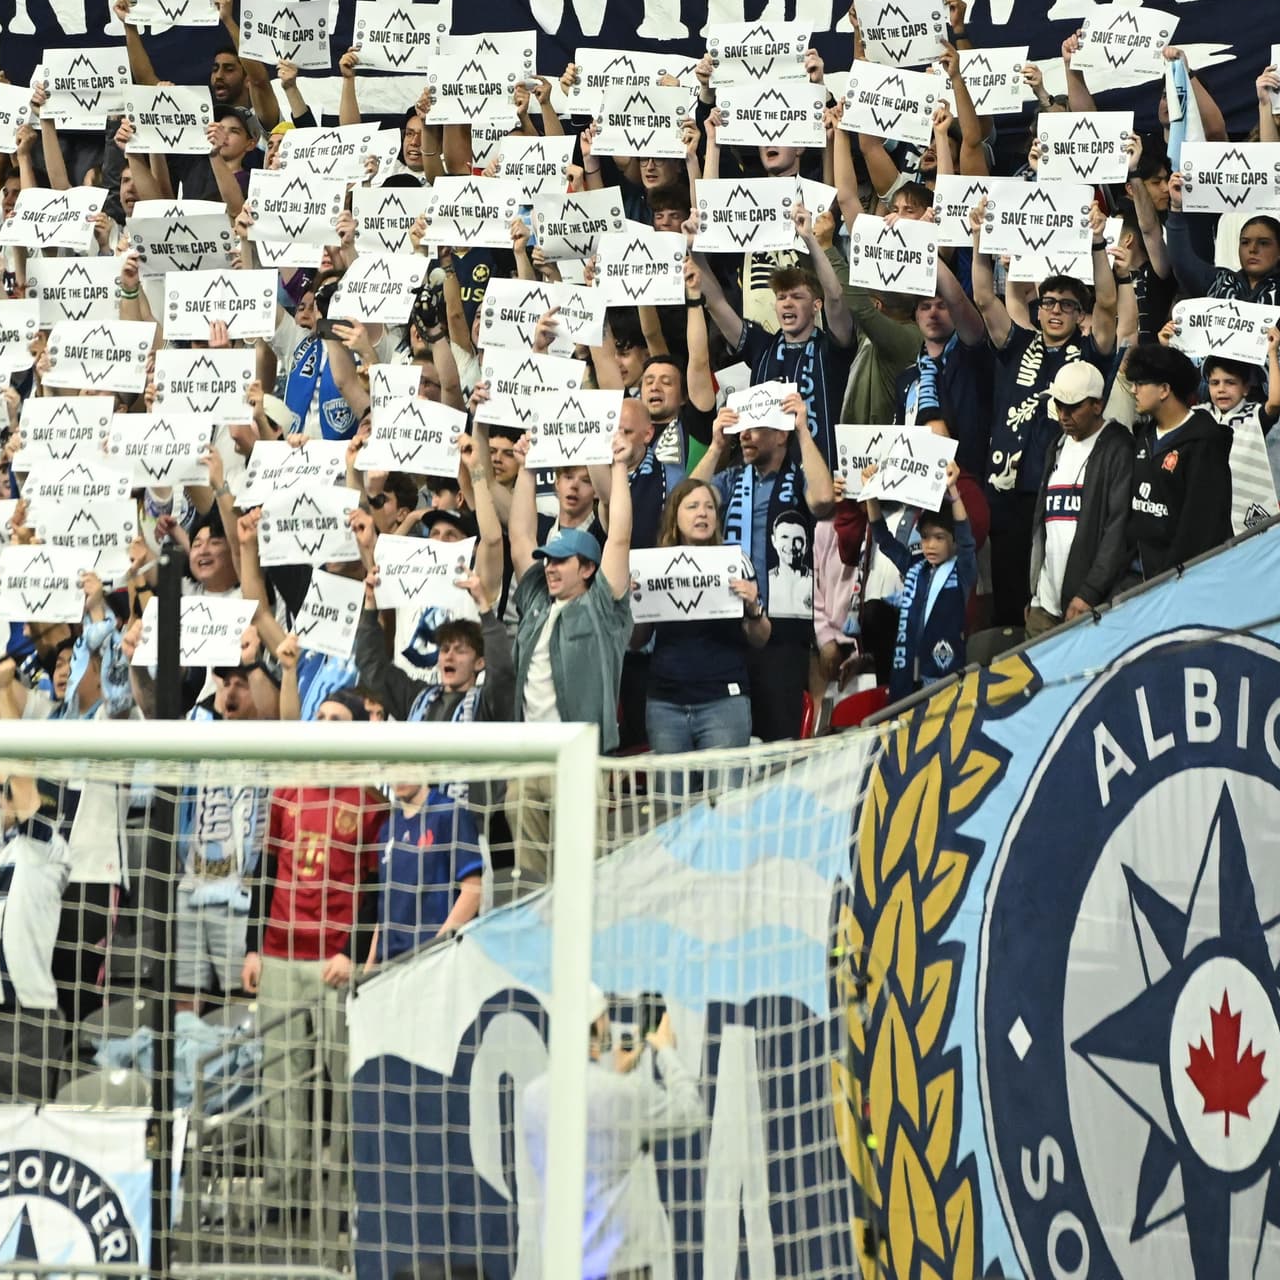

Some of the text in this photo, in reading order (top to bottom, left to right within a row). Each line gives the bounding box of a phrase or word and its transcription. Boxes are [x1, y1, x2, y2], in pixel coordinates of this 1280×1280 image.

[1091, 31, 1152, 48] SAVE THE CAPS
[442, 83, 502, 96] SAVE THE CAPS
[737, 110, 761, 120] SAVE
[780, 111, 806, 120] CAPS
[1054, 142, 1114, 154] SAVE THE CAPS
[1199, 172, 1267, 185] SAVE THE CAPS
[186, 300, 255, 312] SAVE THE CAPS
[171, 381, 236, 393] SAVE THE CAPS
[1046, 495, 1081, 512] TELU
[647, 576, 720, 591] SAVE THE CAPS
